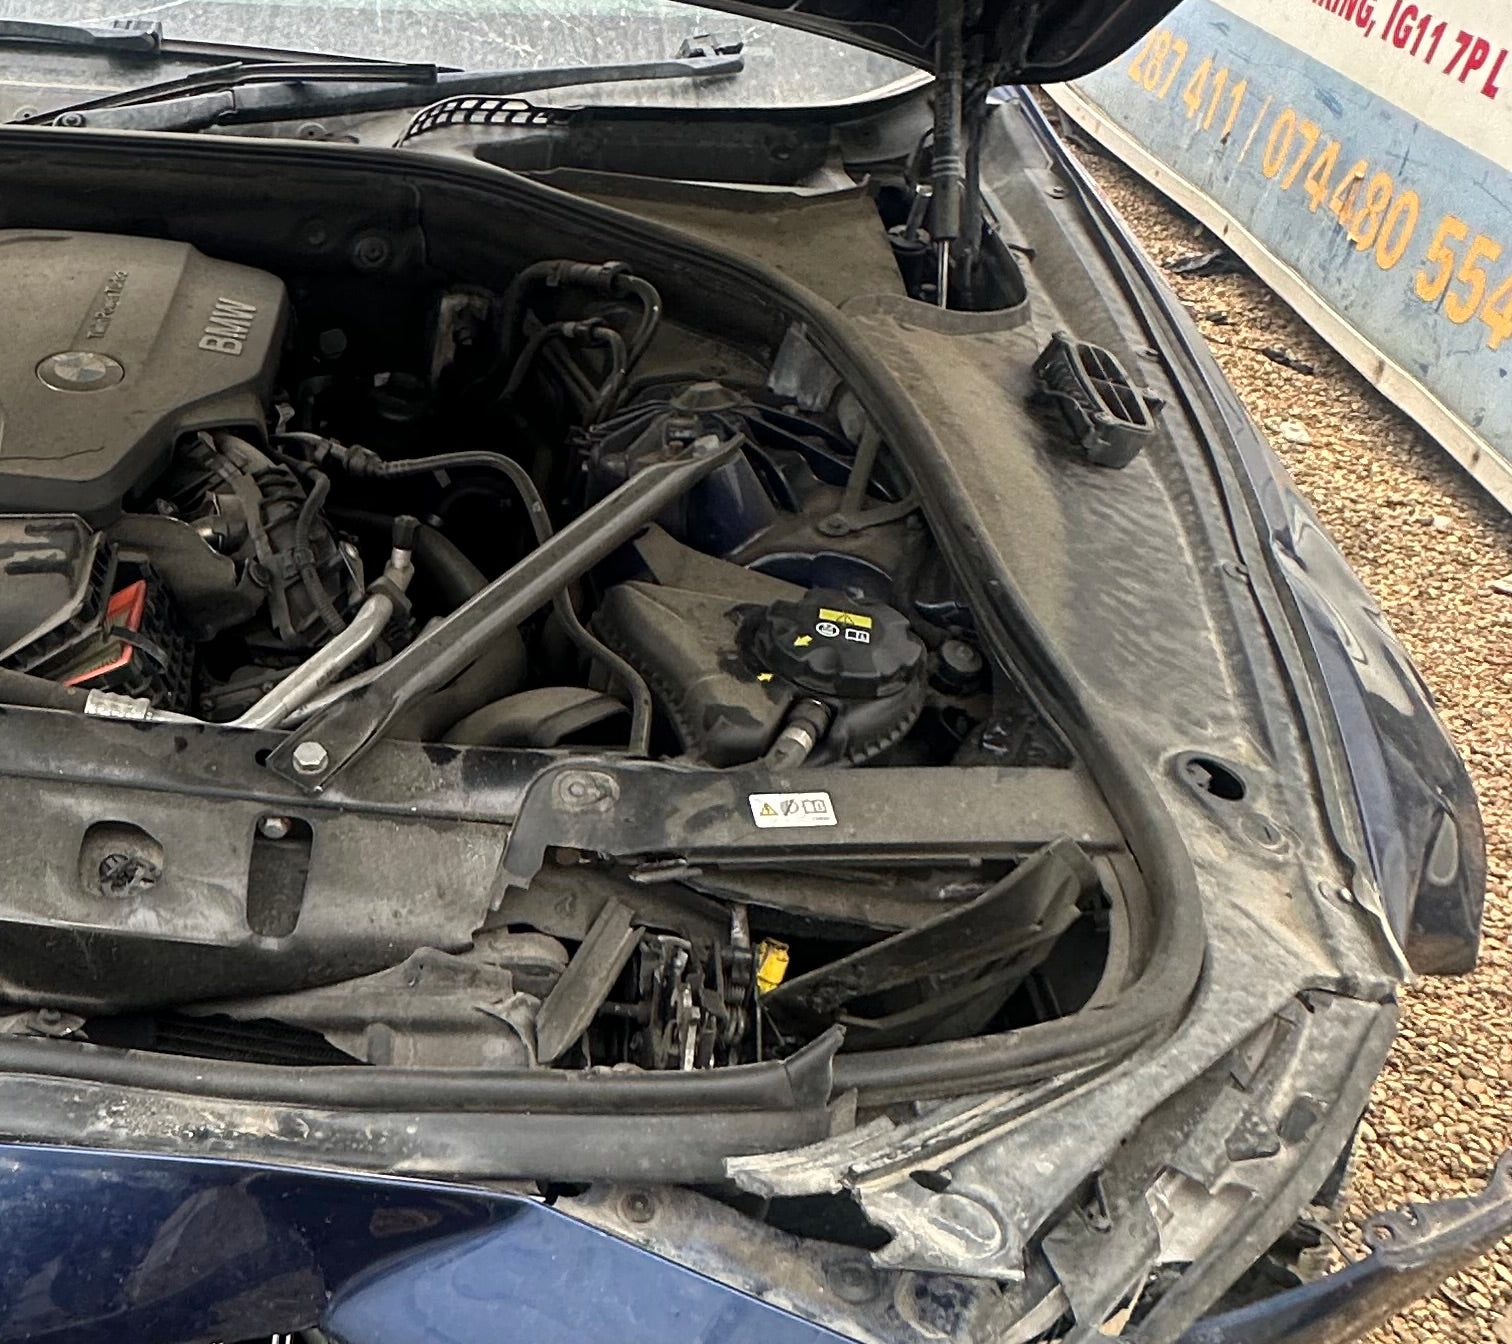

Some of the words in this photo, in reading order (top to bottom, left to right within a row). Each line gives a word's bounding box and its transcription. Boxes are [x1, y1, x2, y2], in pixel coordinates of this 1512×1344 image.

[1183, 57, 1248, 136] 411
[1262, 108, 1421, 271] 074480
[198, 296, 257, 356] BMW
